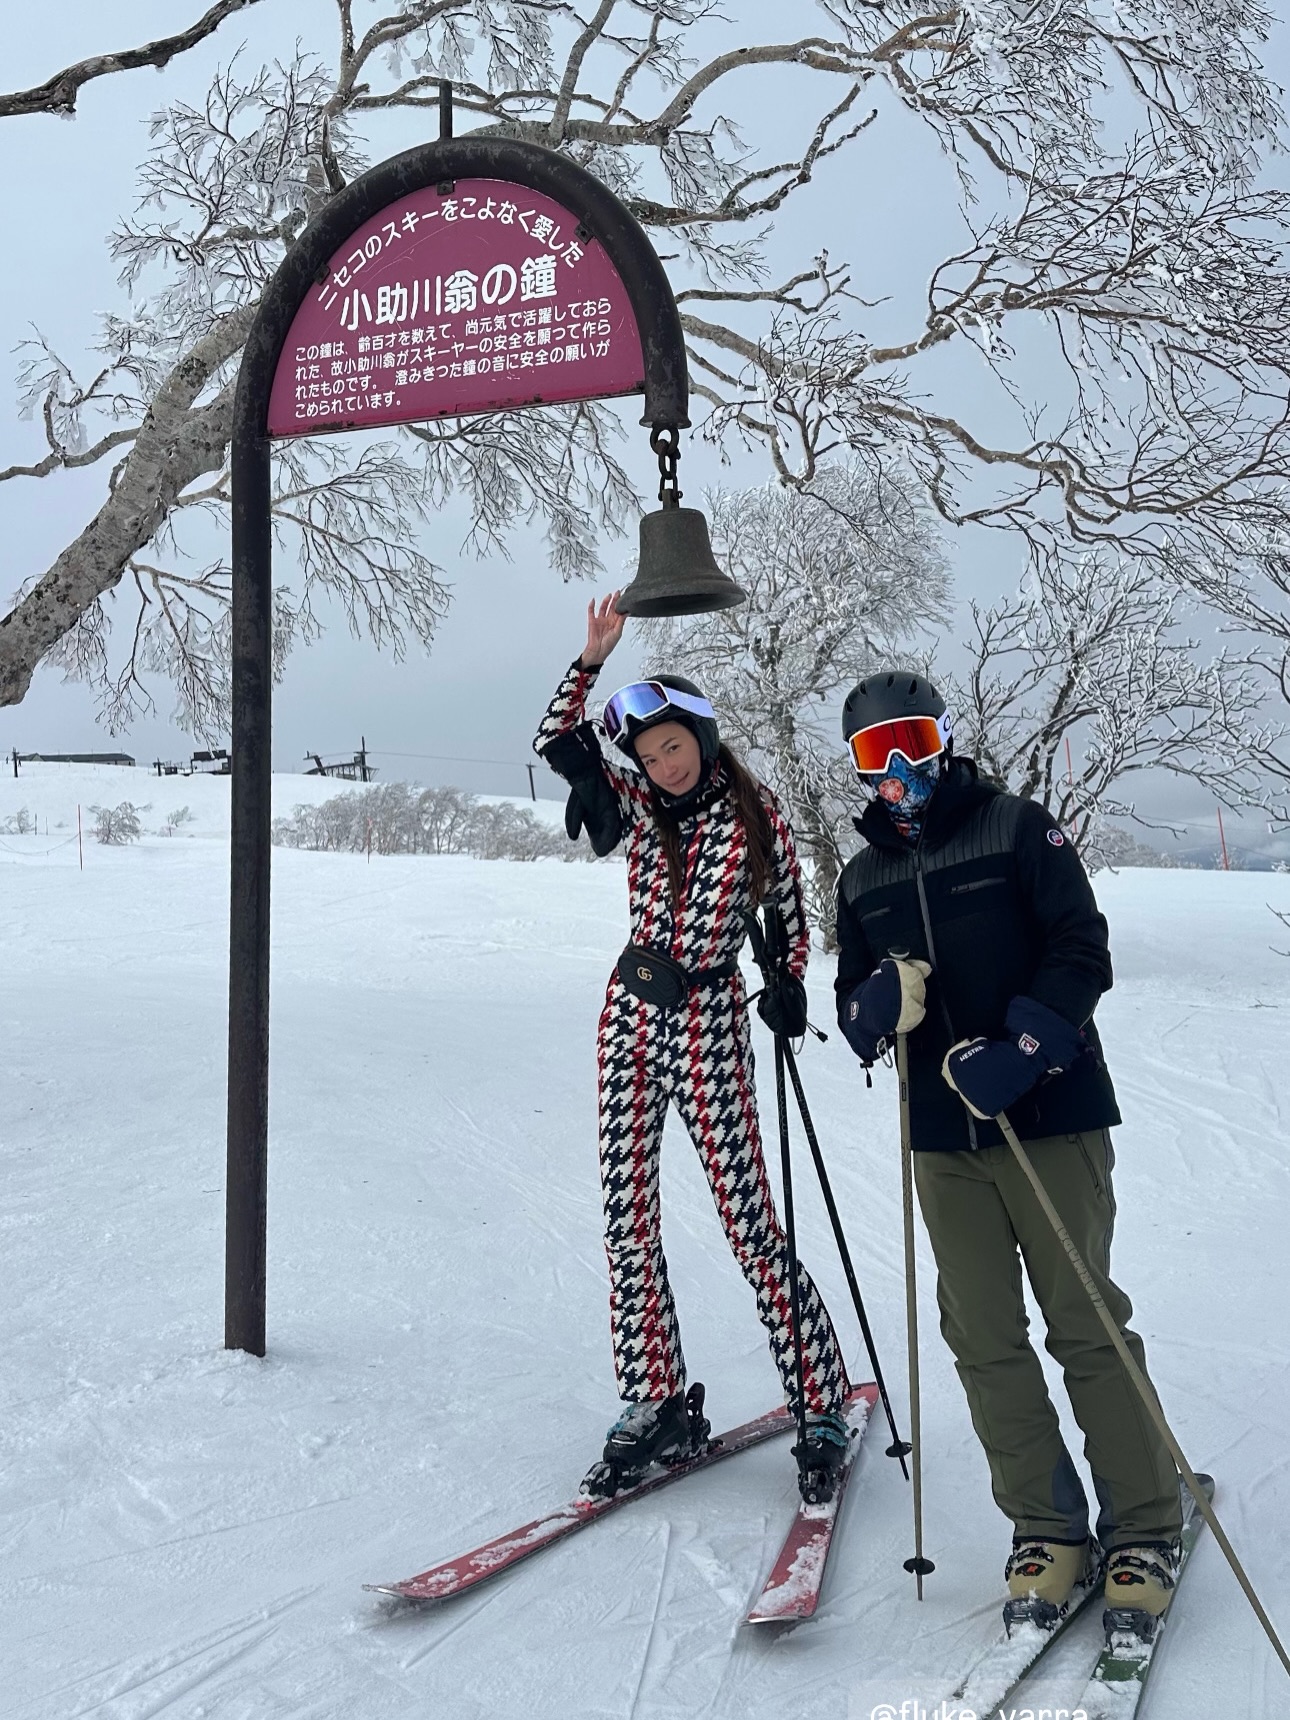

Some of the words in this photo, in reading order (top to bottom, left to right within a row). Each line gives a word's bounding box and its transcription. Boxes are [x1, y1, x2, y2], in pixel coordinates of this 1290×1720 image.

[317, 197, 584, 311] ニセコのスキーをこよなく愛した
[340, 254, 558, 331] 小助川翁の鐘
[295, 390, 401, 418] こめられています。
